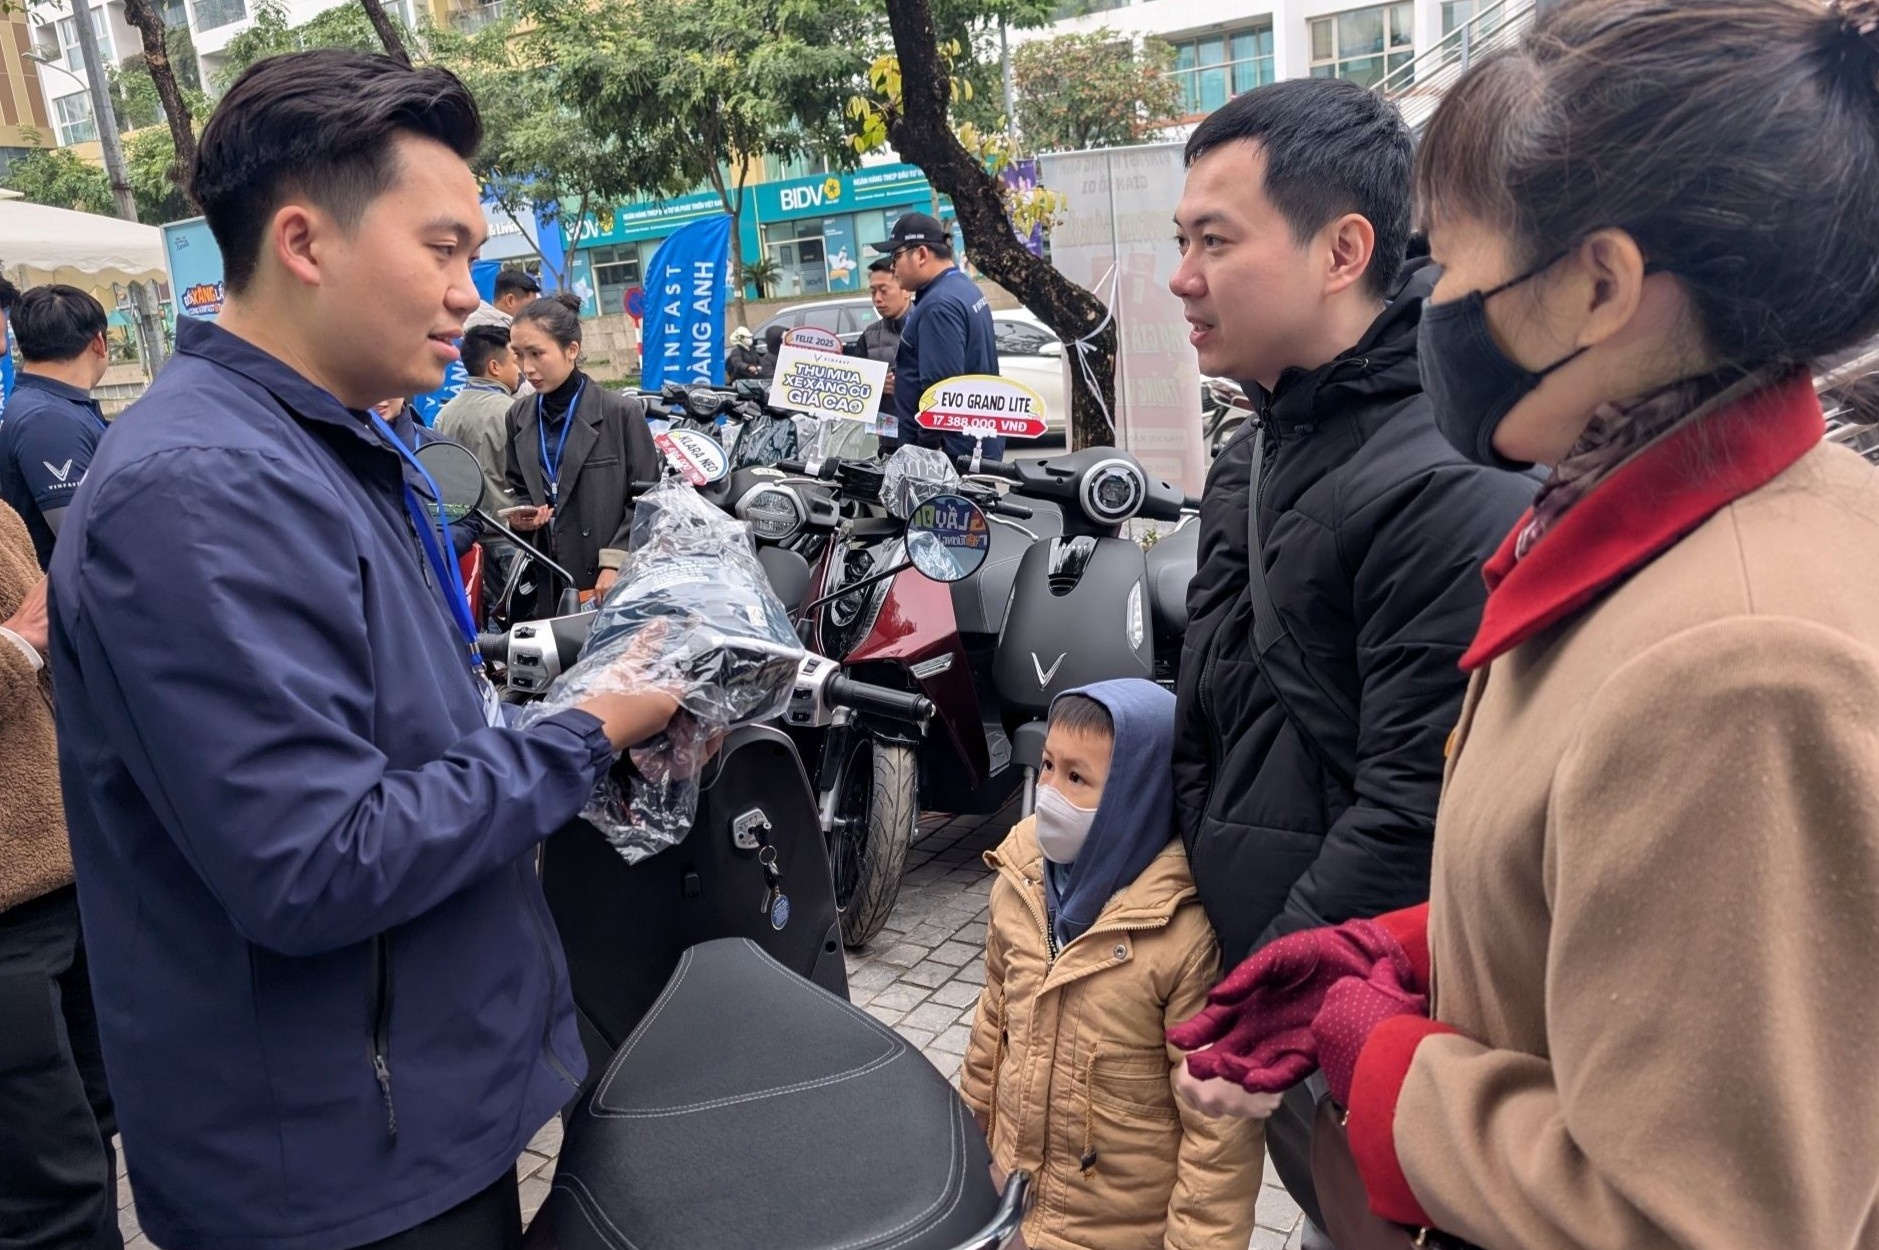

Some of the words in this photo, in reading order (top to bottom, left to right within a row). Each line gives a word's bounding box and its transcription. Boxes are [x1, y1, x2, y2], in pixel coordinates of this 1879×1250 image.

[780, 183, 824, 211] BIDV
[488, 223, 496, 236] &
[693, 261, 715, 315] ANH
[795, 334, 814, 344] FELIZ
[815, 338, 834, 348] 2025
[796, 362, 827, 378] THU
[827, 366, 861, 384] MUA
[783, 374, 804, 388] XE
[804, 376, 847, 396] XĂNG
[848, 383, 871, 399] CŨ
[788, 389, 821, 407] GIÁ
[822, 394, 864, 414] CAO
[941, 392, 963, 408] EVO
[967, 394, 1005, 411] GRAND
[1009, 397, 1031, 413] LITE
[933, 415, 996, 429] 17.388.000
[1000, 420, 1027, 432] VNĐ
[680, 435, 705, 459] KLARA
[700, 458, 719, 473] NEO
